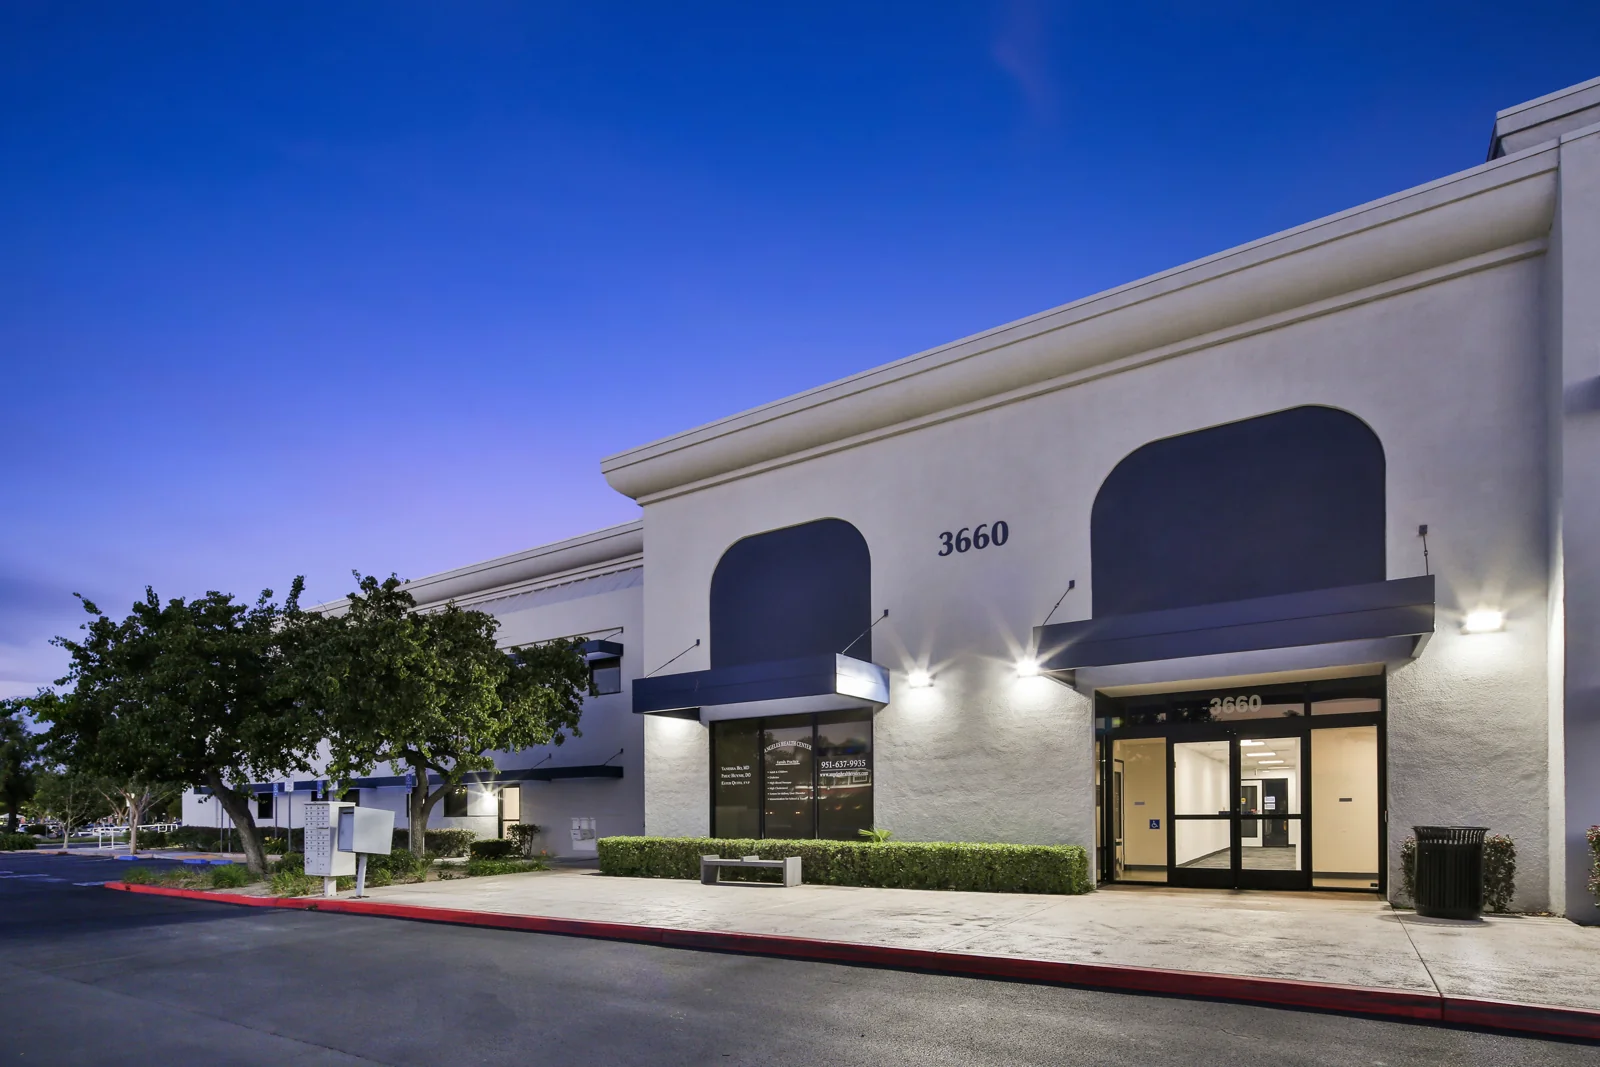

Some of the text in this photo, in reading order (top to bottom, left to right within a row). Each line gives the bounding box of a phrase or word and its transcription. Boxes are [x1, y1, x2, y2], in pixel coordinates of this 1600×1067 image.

[938, 520, 1009, 556] 3660
[1209, 694, 1262, 715] 3660
[797, 741, 812, 751] CENTER
[821, 759, 866, 769] 951-637-9935
